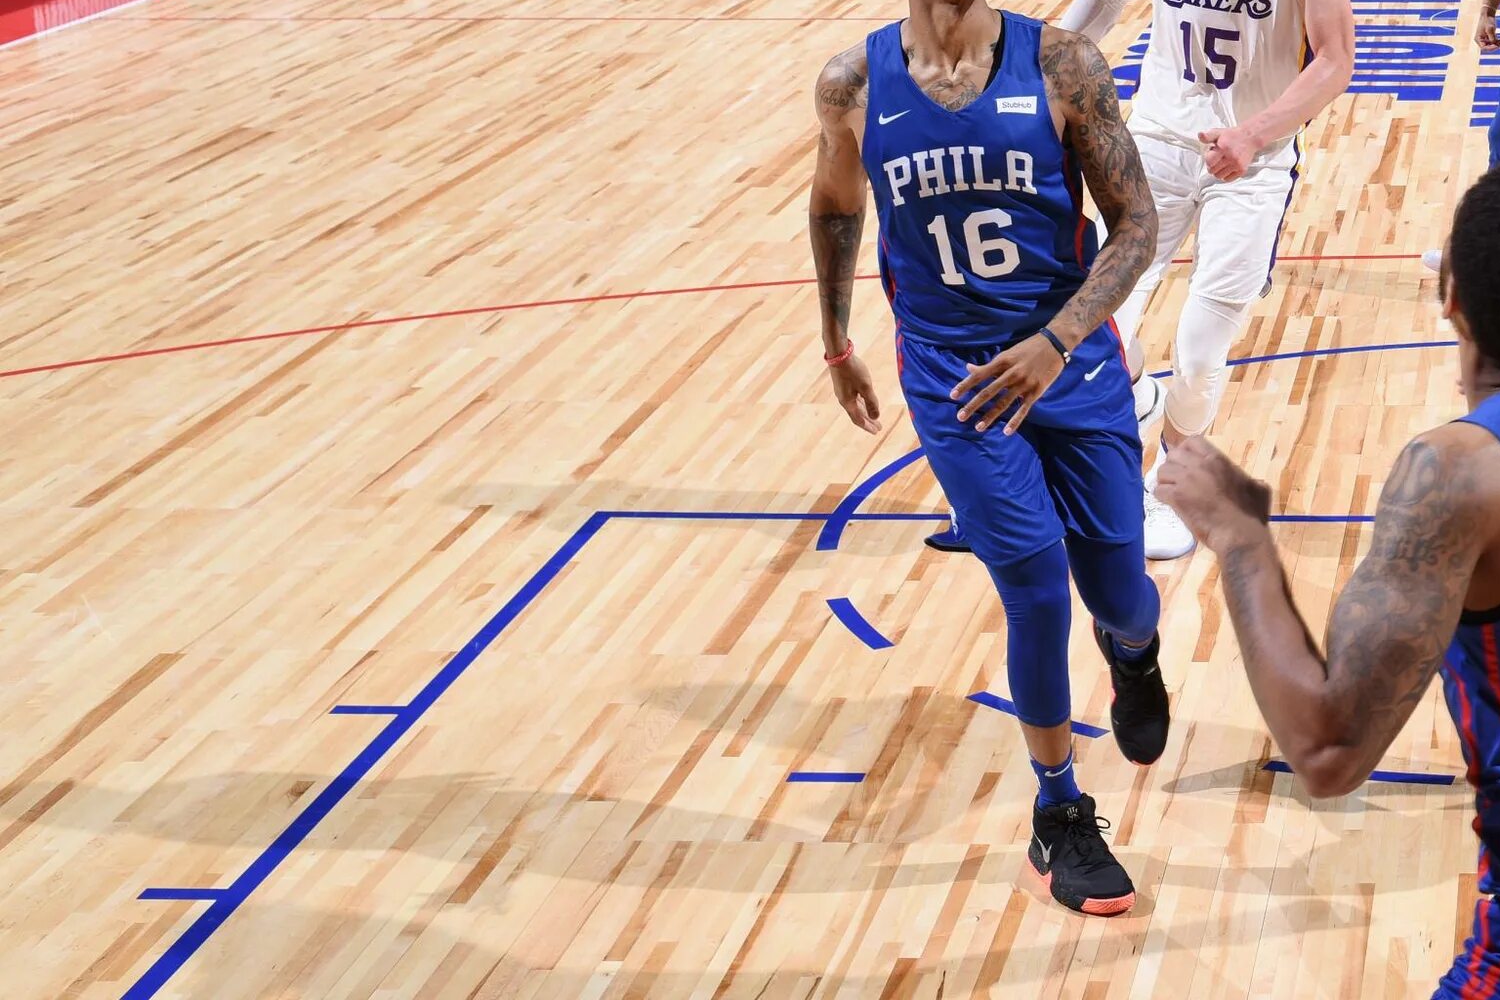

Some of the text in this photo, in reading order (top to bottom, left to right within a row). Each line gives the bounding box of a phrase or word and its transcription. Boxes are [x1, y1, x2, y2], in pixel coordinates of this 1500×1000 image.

[1180, 20, 1240, 90] 15
[1001, 101, 1032, 109] StubHub
[883, 146, 1037, 207] PHILA
[927, 208, 1020, 286] 16
